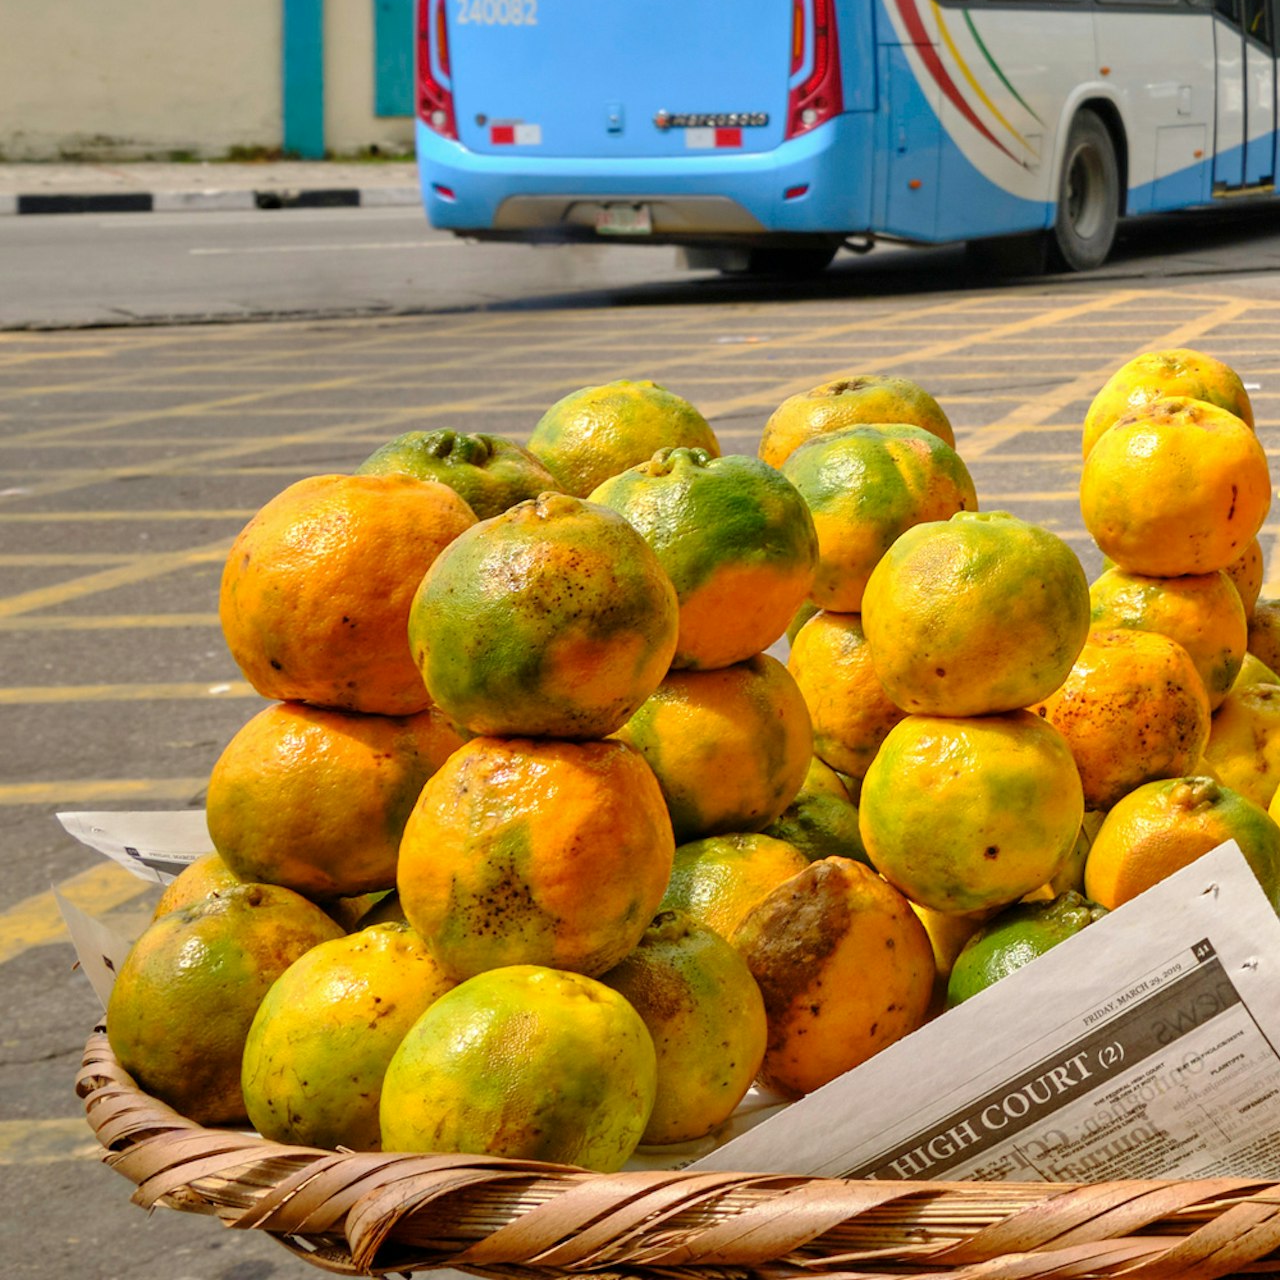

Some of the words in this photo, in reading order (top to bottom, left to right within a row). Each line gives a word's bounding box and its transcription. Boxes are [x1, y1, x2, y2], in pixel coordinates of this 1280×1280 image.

[1081, 1004, 1118, 1027] FRIDAY,
[1116, 981, 1150, 1012] MARCH
[1160, 963, 1183, 984] 2019
[1144, 1062, 1165, 1076] COURT
[890, 1119, 988, 1180] HIGH
[980, 1050, 1100, 1131] COURT
[1097, 1041, 1126, 1071] (2)
